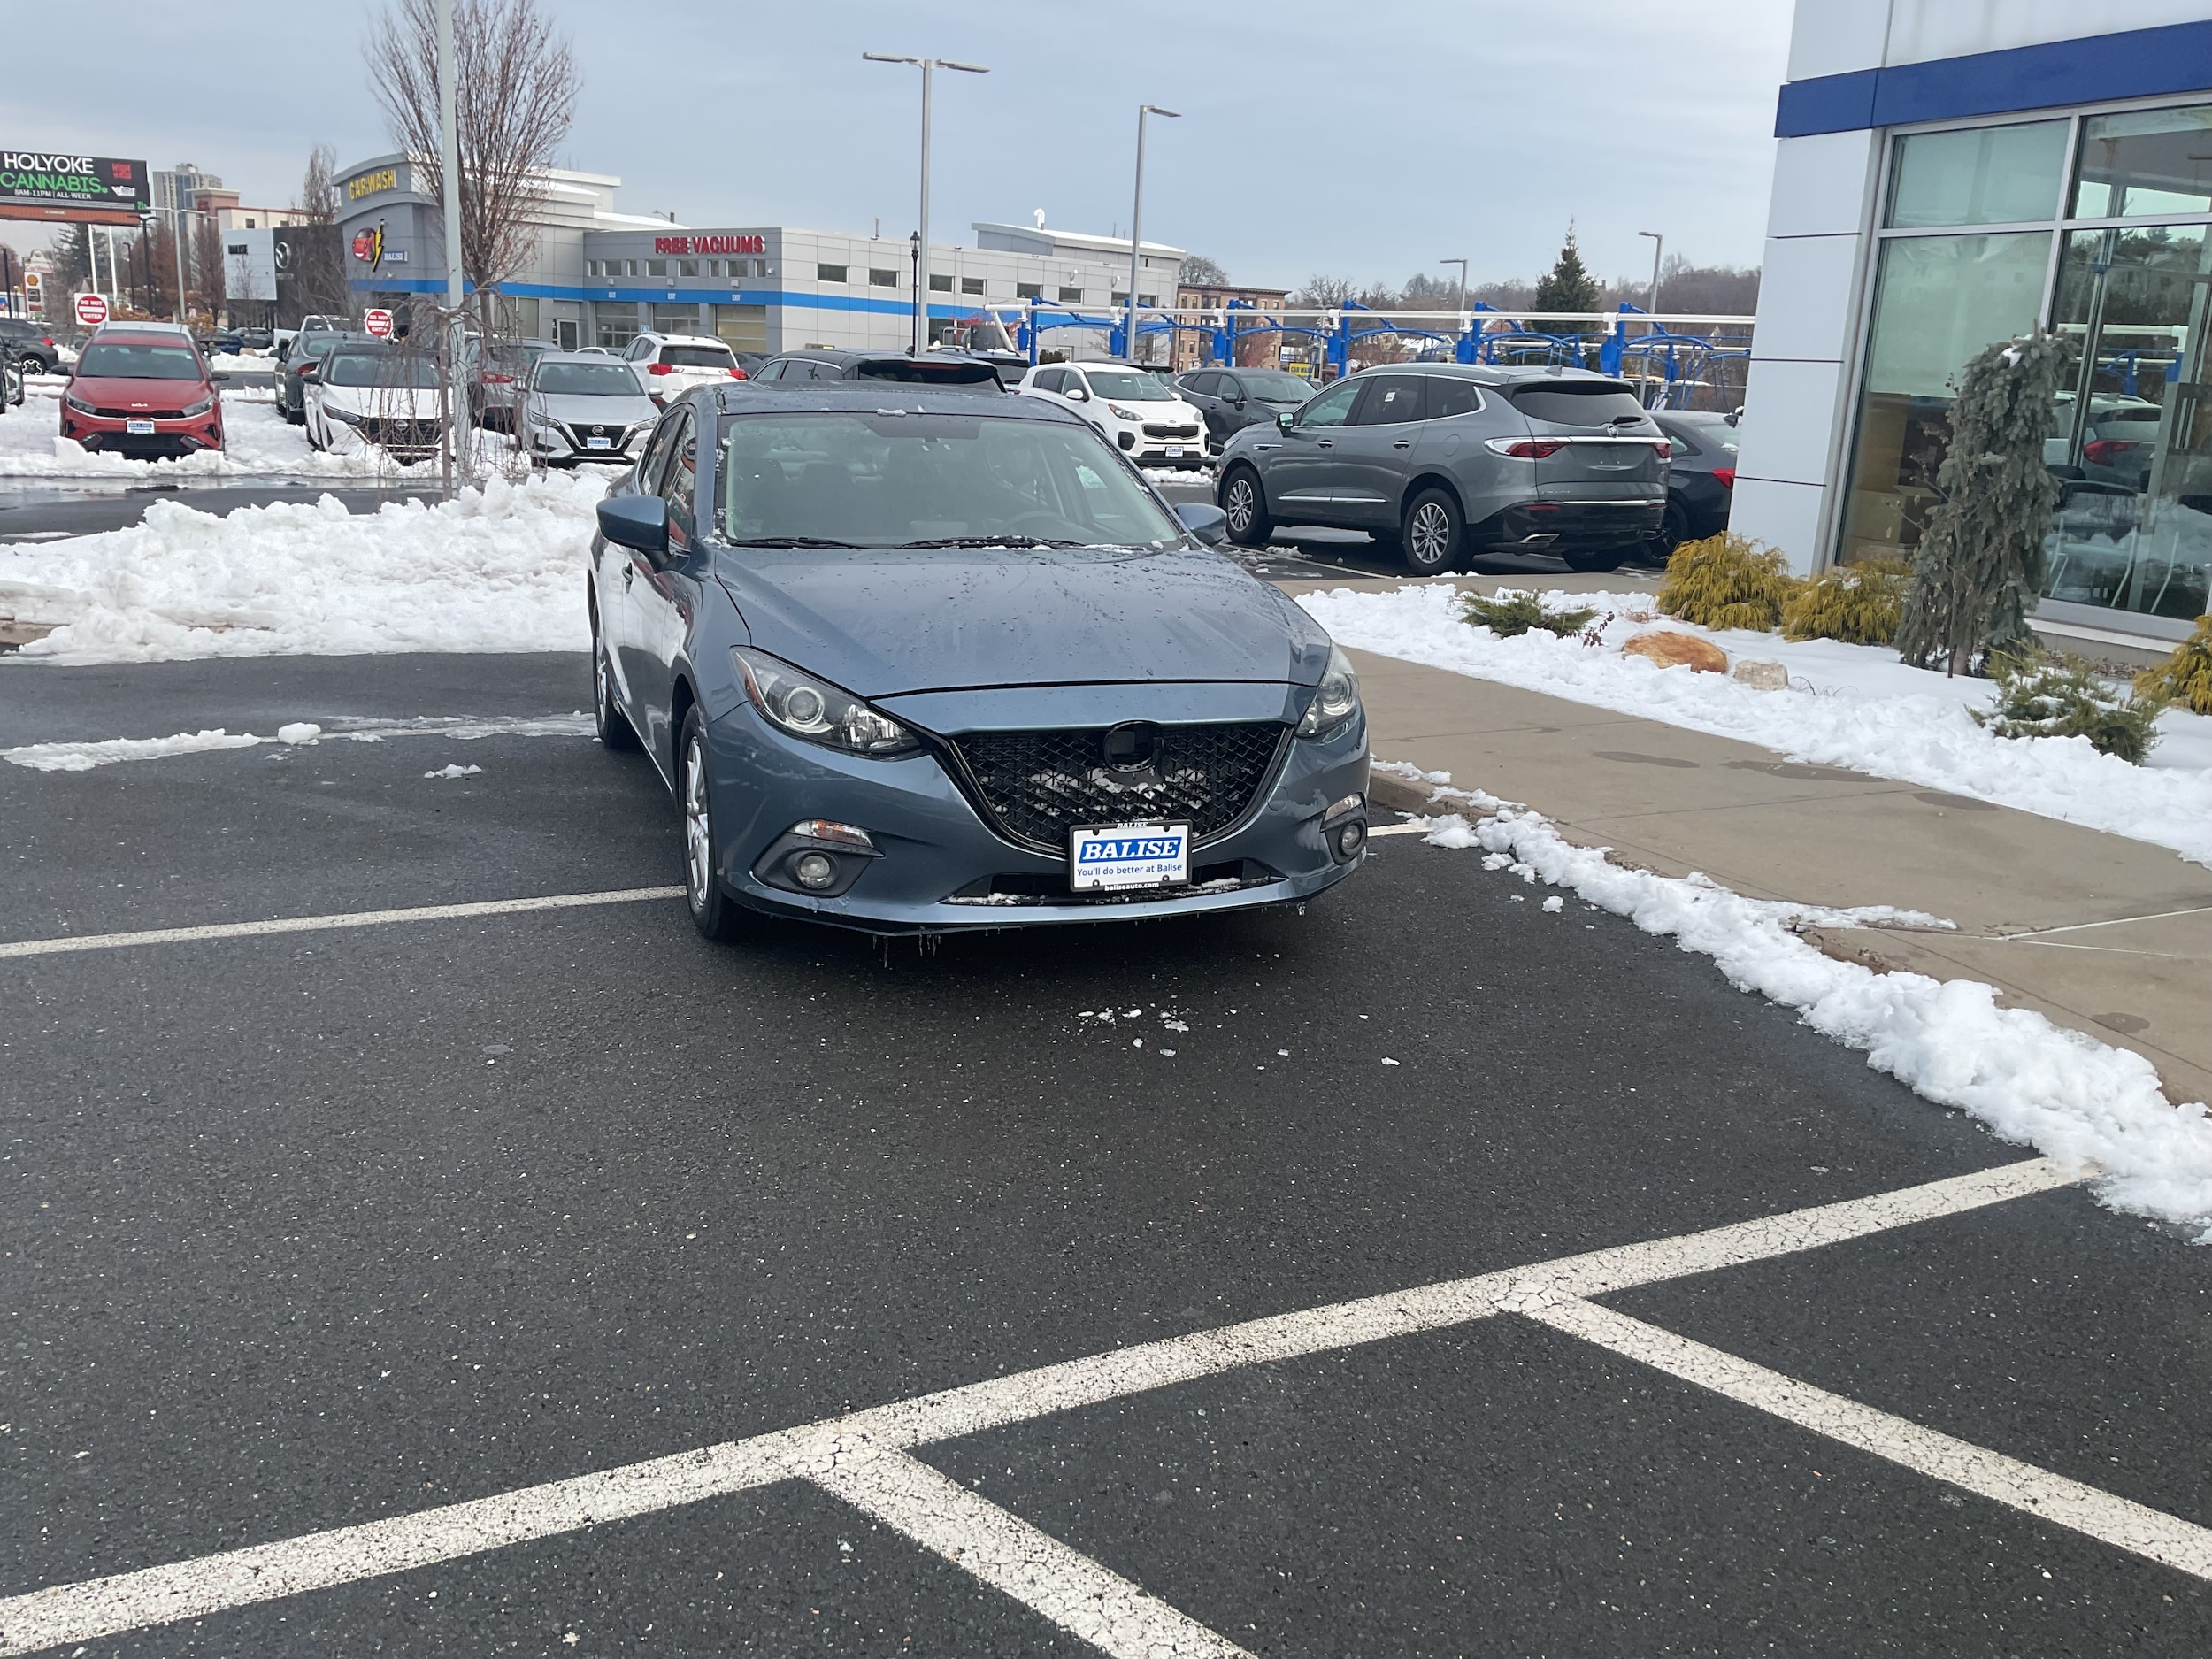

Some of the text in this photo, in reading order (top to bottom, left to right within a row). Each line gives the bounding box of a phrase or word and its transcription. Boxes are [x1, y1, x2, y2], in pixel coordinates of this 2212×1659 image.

[4, 152, 95, 174] HOLYOKE
[349, 170, 397, 200] CAR WASH
[655, 235, 765, 254] FREE VACUUMS
[384, 252, 404, 261] BALISE
[1082, 840, 1179, 861] BALISE
[1078, 866, 1101, 877] You'll
[1103, 866, 1114, 875] do
[1117, 864, 1143, 874] better
[1157, 864, 1182, 872] Balise
[1104, 881, 1160, 892] baliseauto.com
